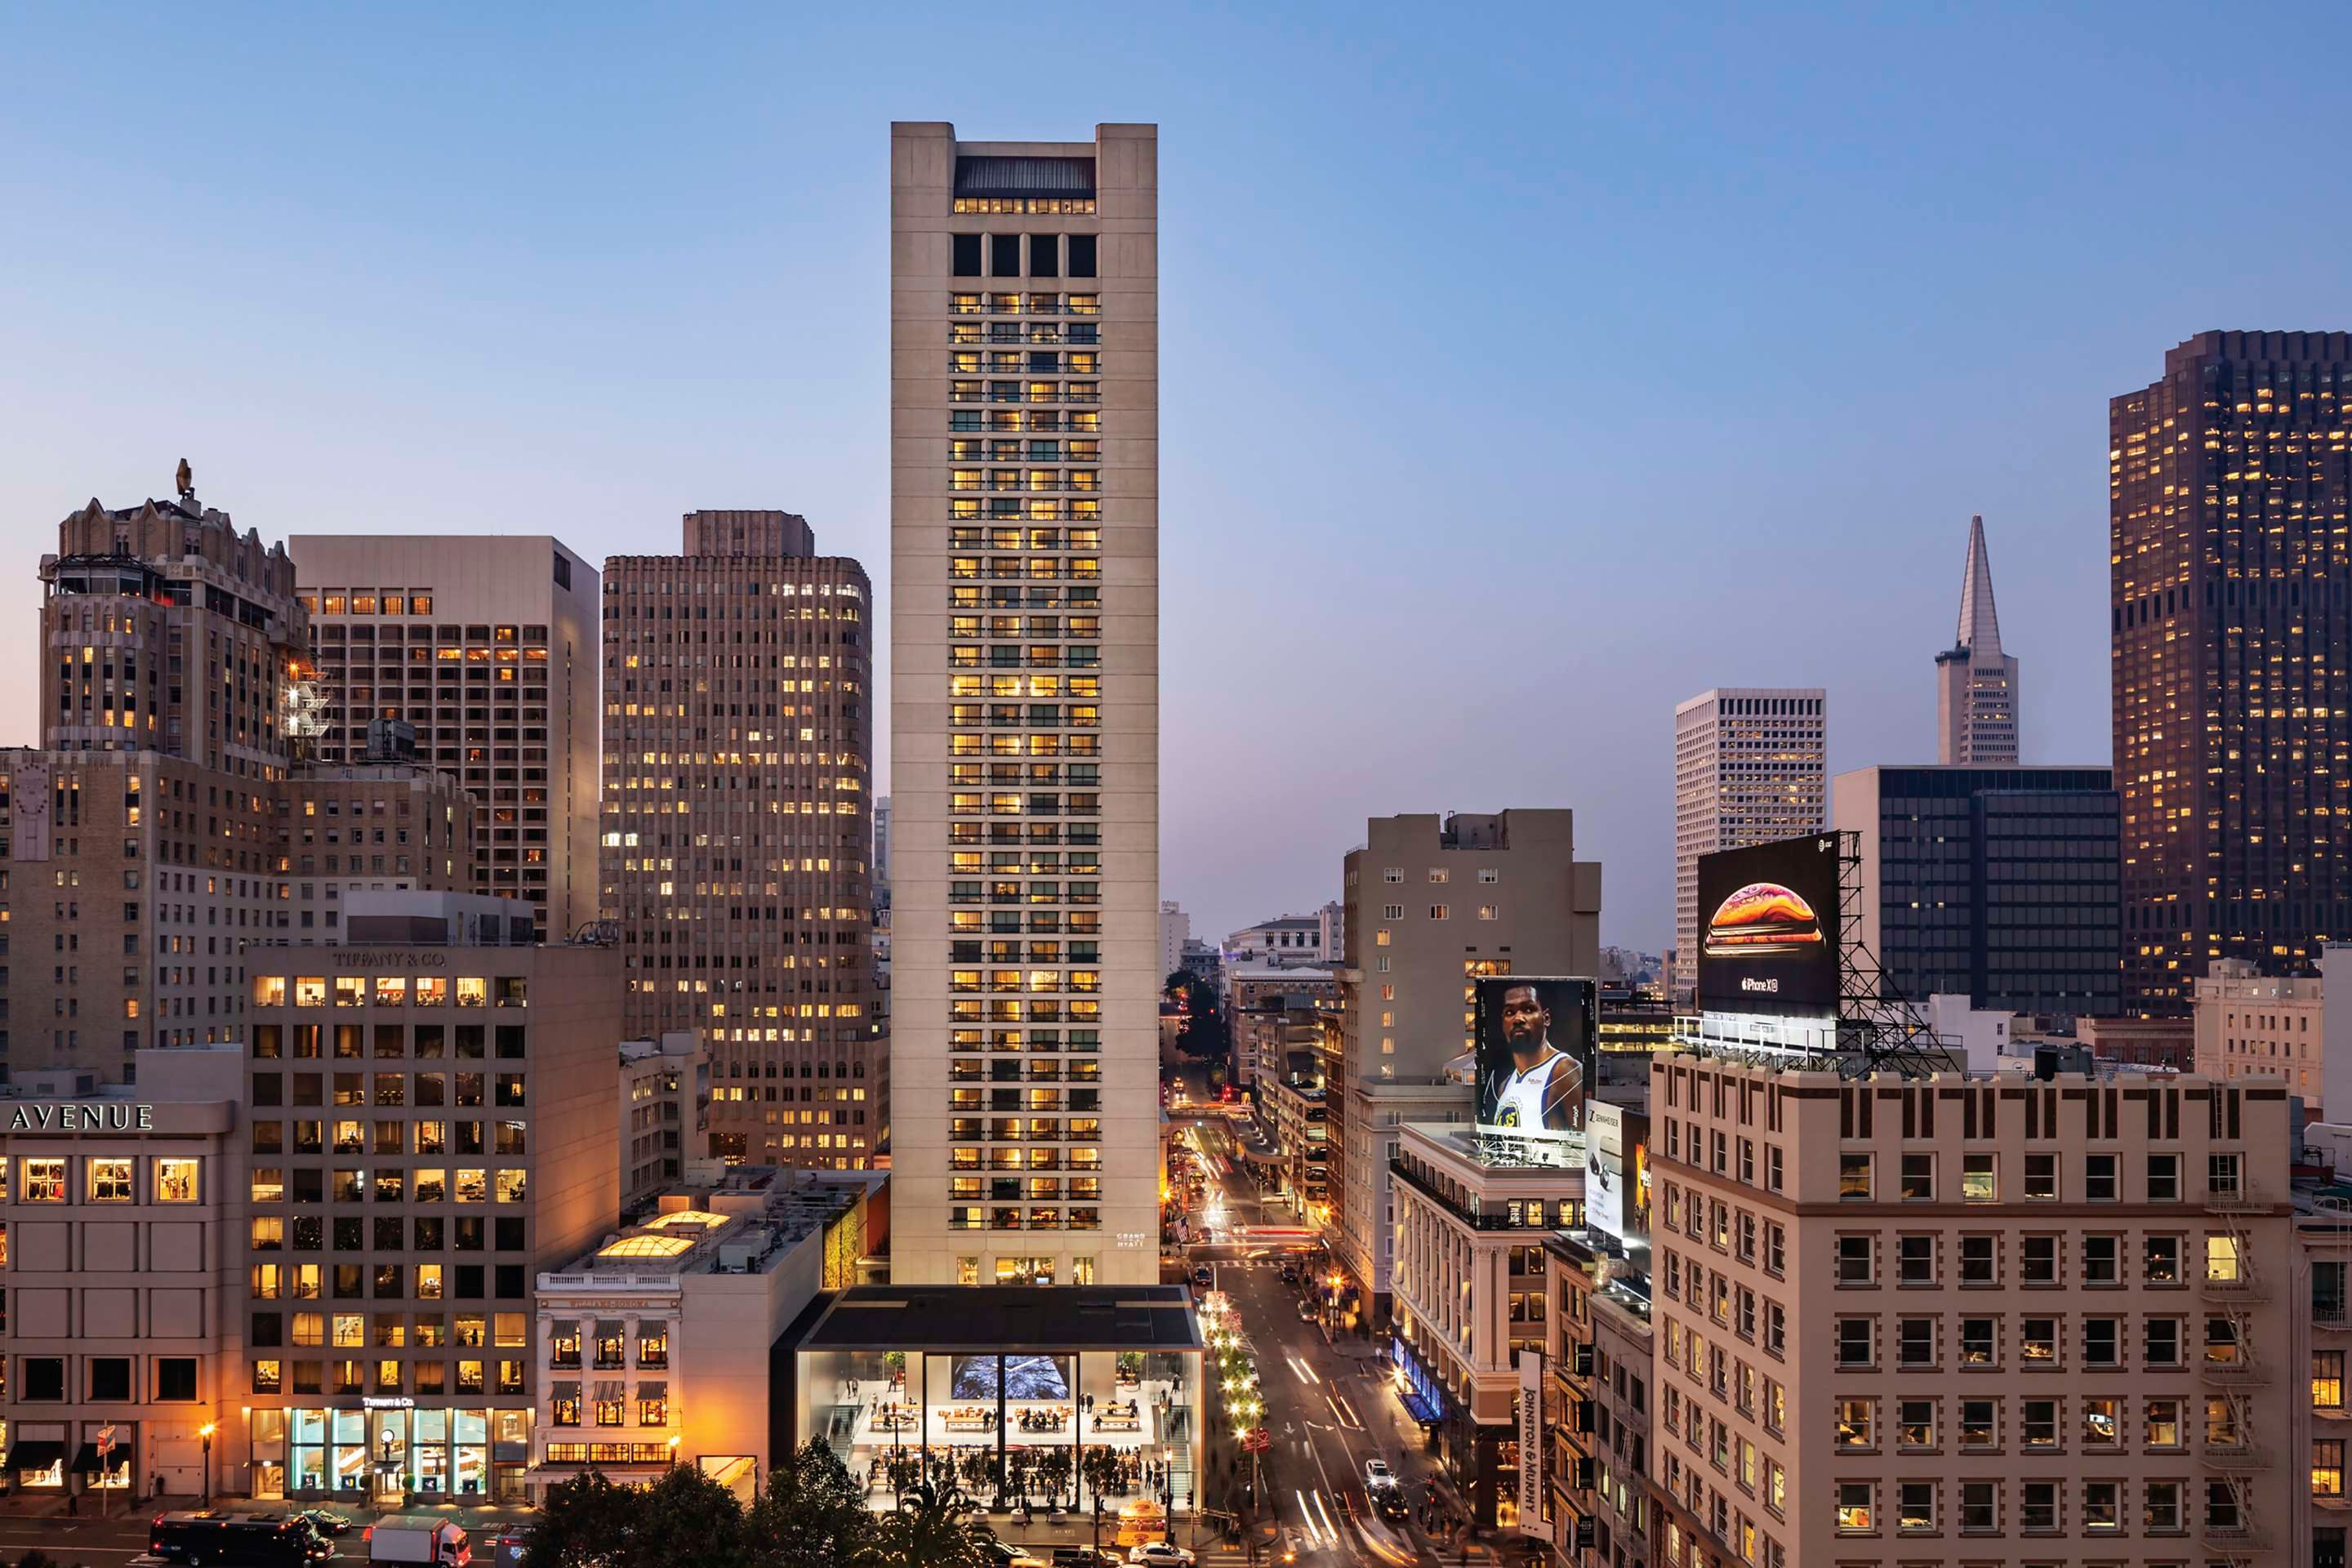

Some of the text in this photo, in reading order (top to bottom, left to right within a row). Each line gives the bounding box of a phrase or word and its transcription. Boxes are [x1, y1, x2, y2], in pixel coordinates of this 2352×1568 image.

[333, 953, 403, 967] TIFFANY
[408, 953, 417, 967] &
[1747, 978, 1766, 991] iPhone
[11, 1105, 153, 1130] AVENUE
[1117, 1240, 1144, 1248] HYATT
[1523, 1386, 1537, 1513] JOHNSTON & MURPHY
